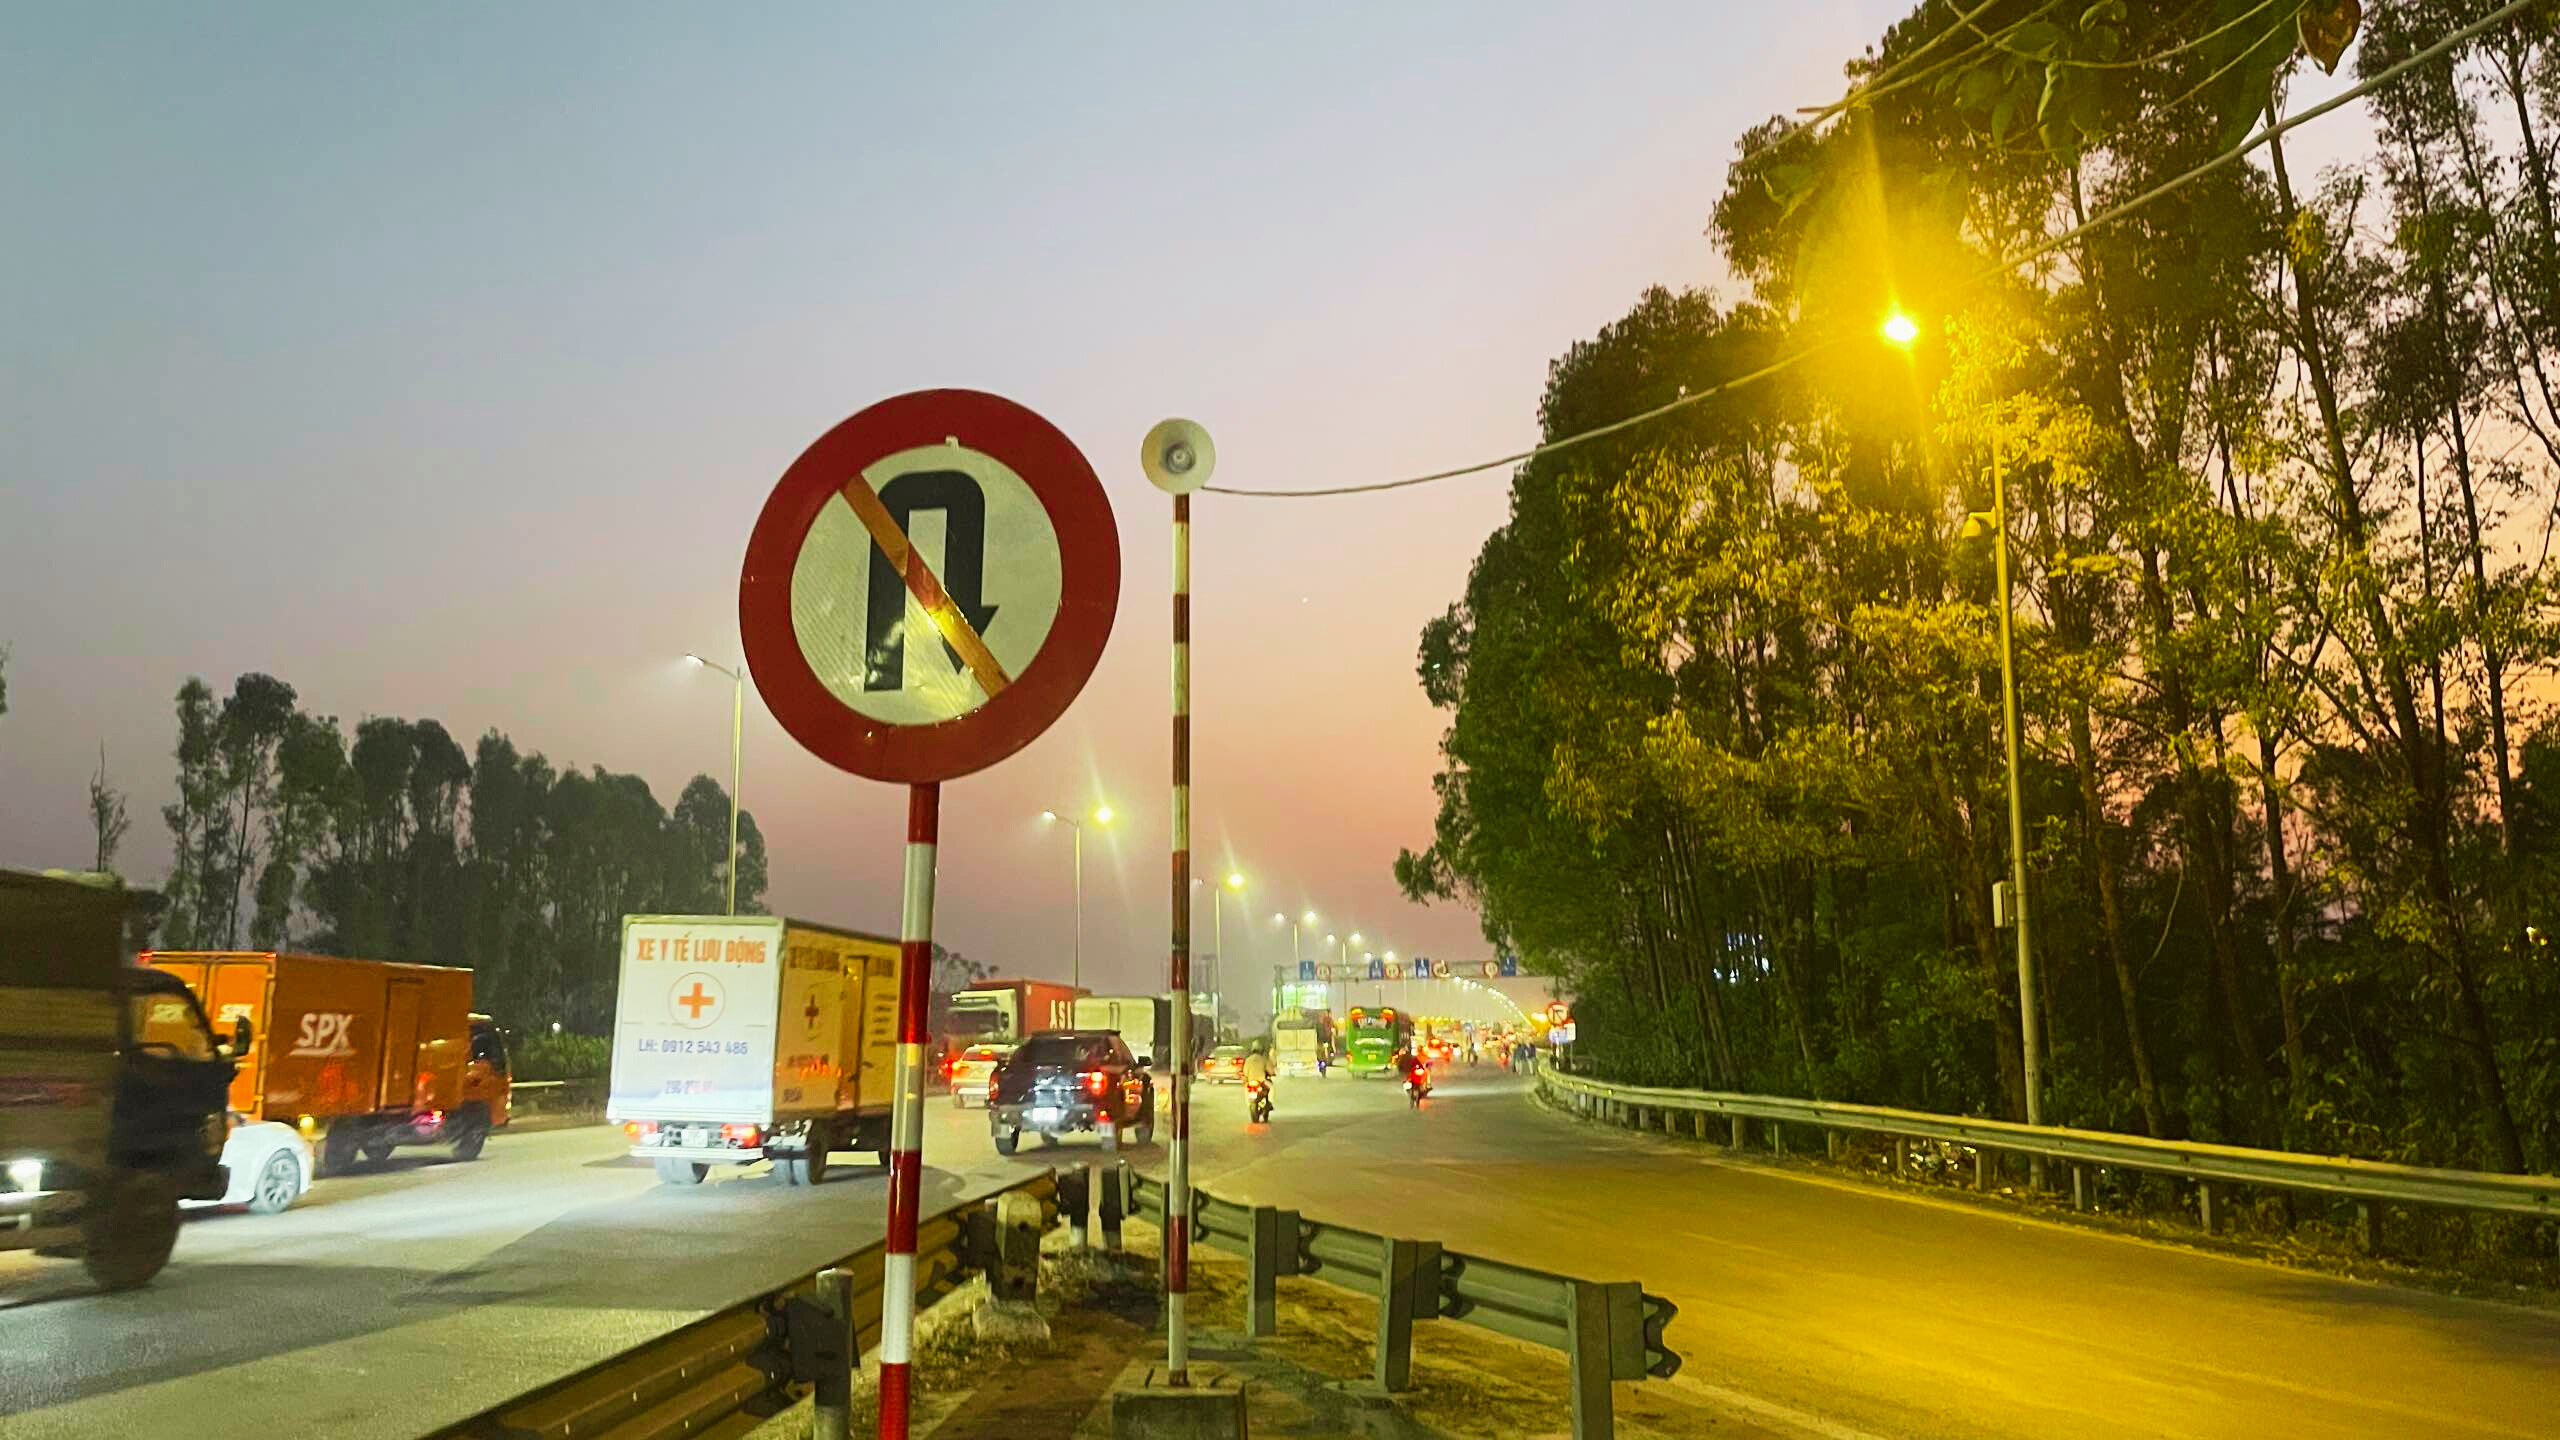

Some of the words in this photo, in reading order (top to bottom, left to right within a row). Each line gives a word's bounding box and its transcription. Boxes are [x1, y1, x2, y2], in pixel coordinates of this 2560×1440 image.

[637, 938, 655, 960] XE
[661, 939, 668, 960] Y
[299, 1013, 352, 1048] SPX
